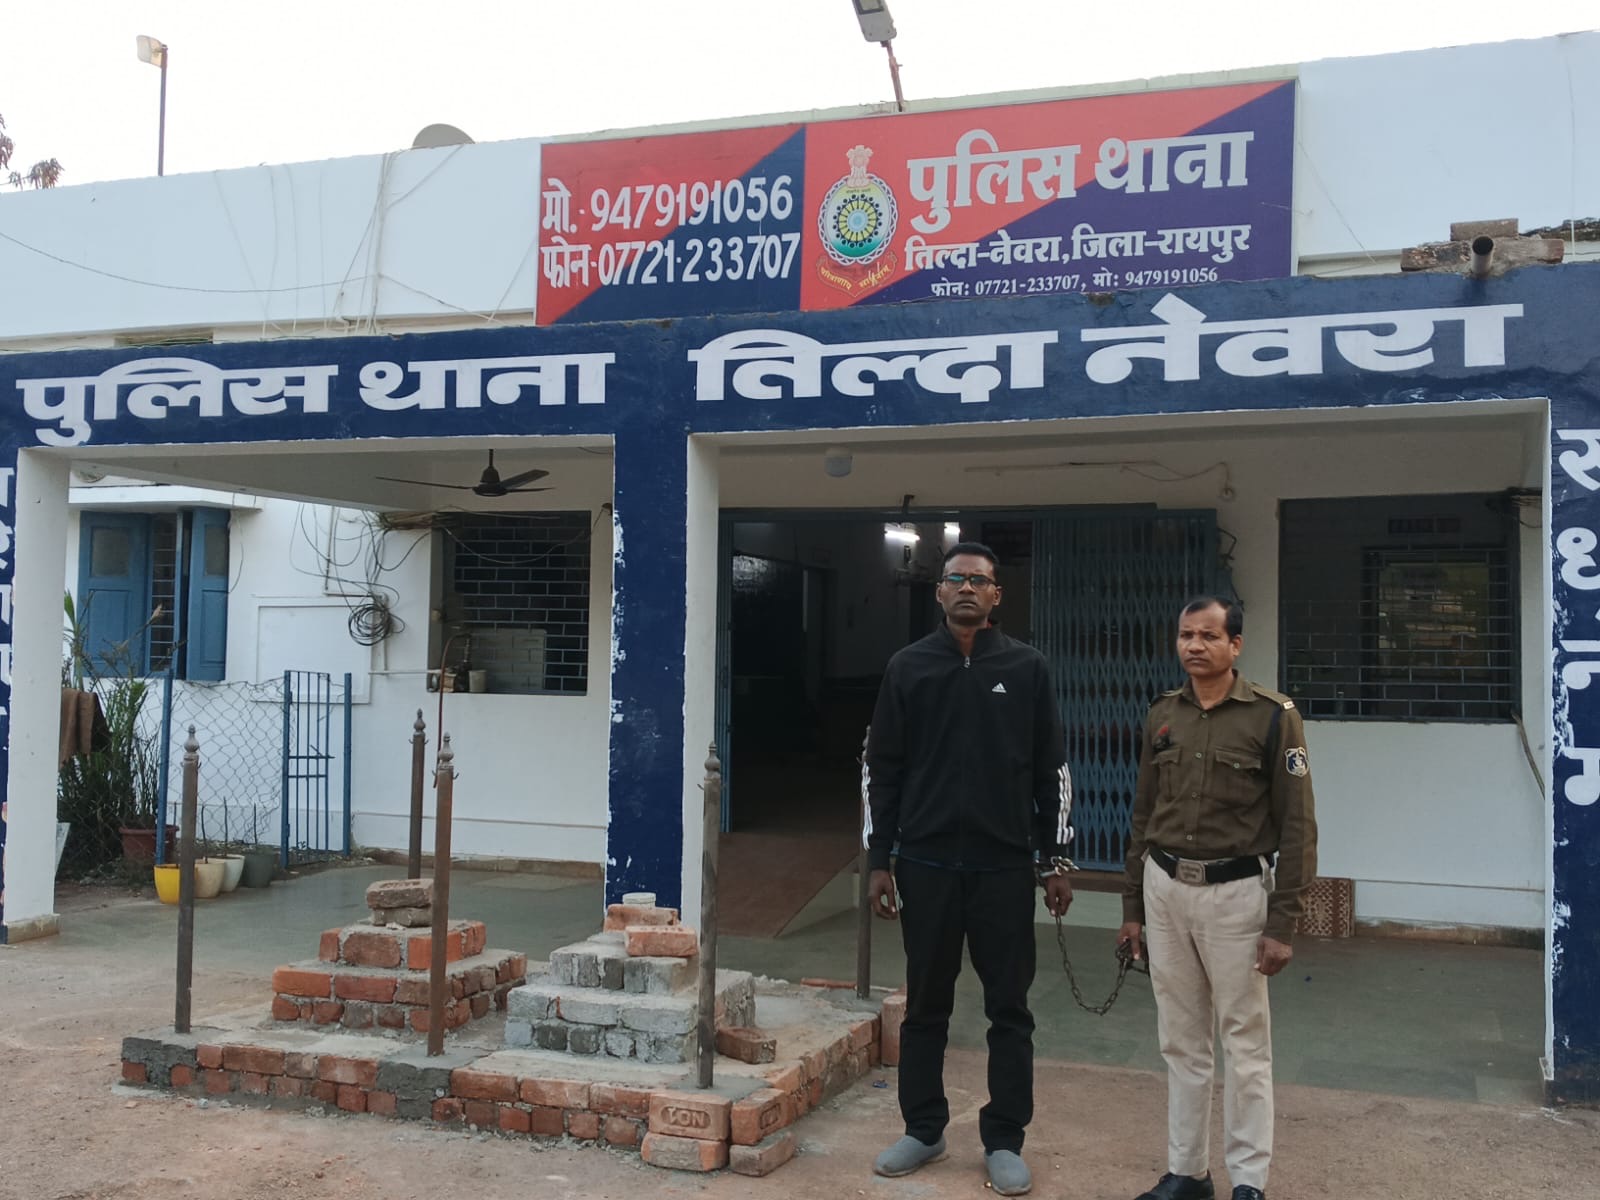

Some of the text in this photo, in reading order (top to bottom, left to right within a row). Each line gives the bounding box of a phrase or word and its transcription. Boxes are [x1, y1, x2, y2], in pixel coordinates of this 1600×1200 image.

[591, 175, 793, 232] 9479191056
[907, 129, 1255, 234] पुलिस थाना
[1125, 267, 1219, 286] 9479191056
[15, 291, 1524, 446] पुलिस थाना तिल्दा नेवरा
